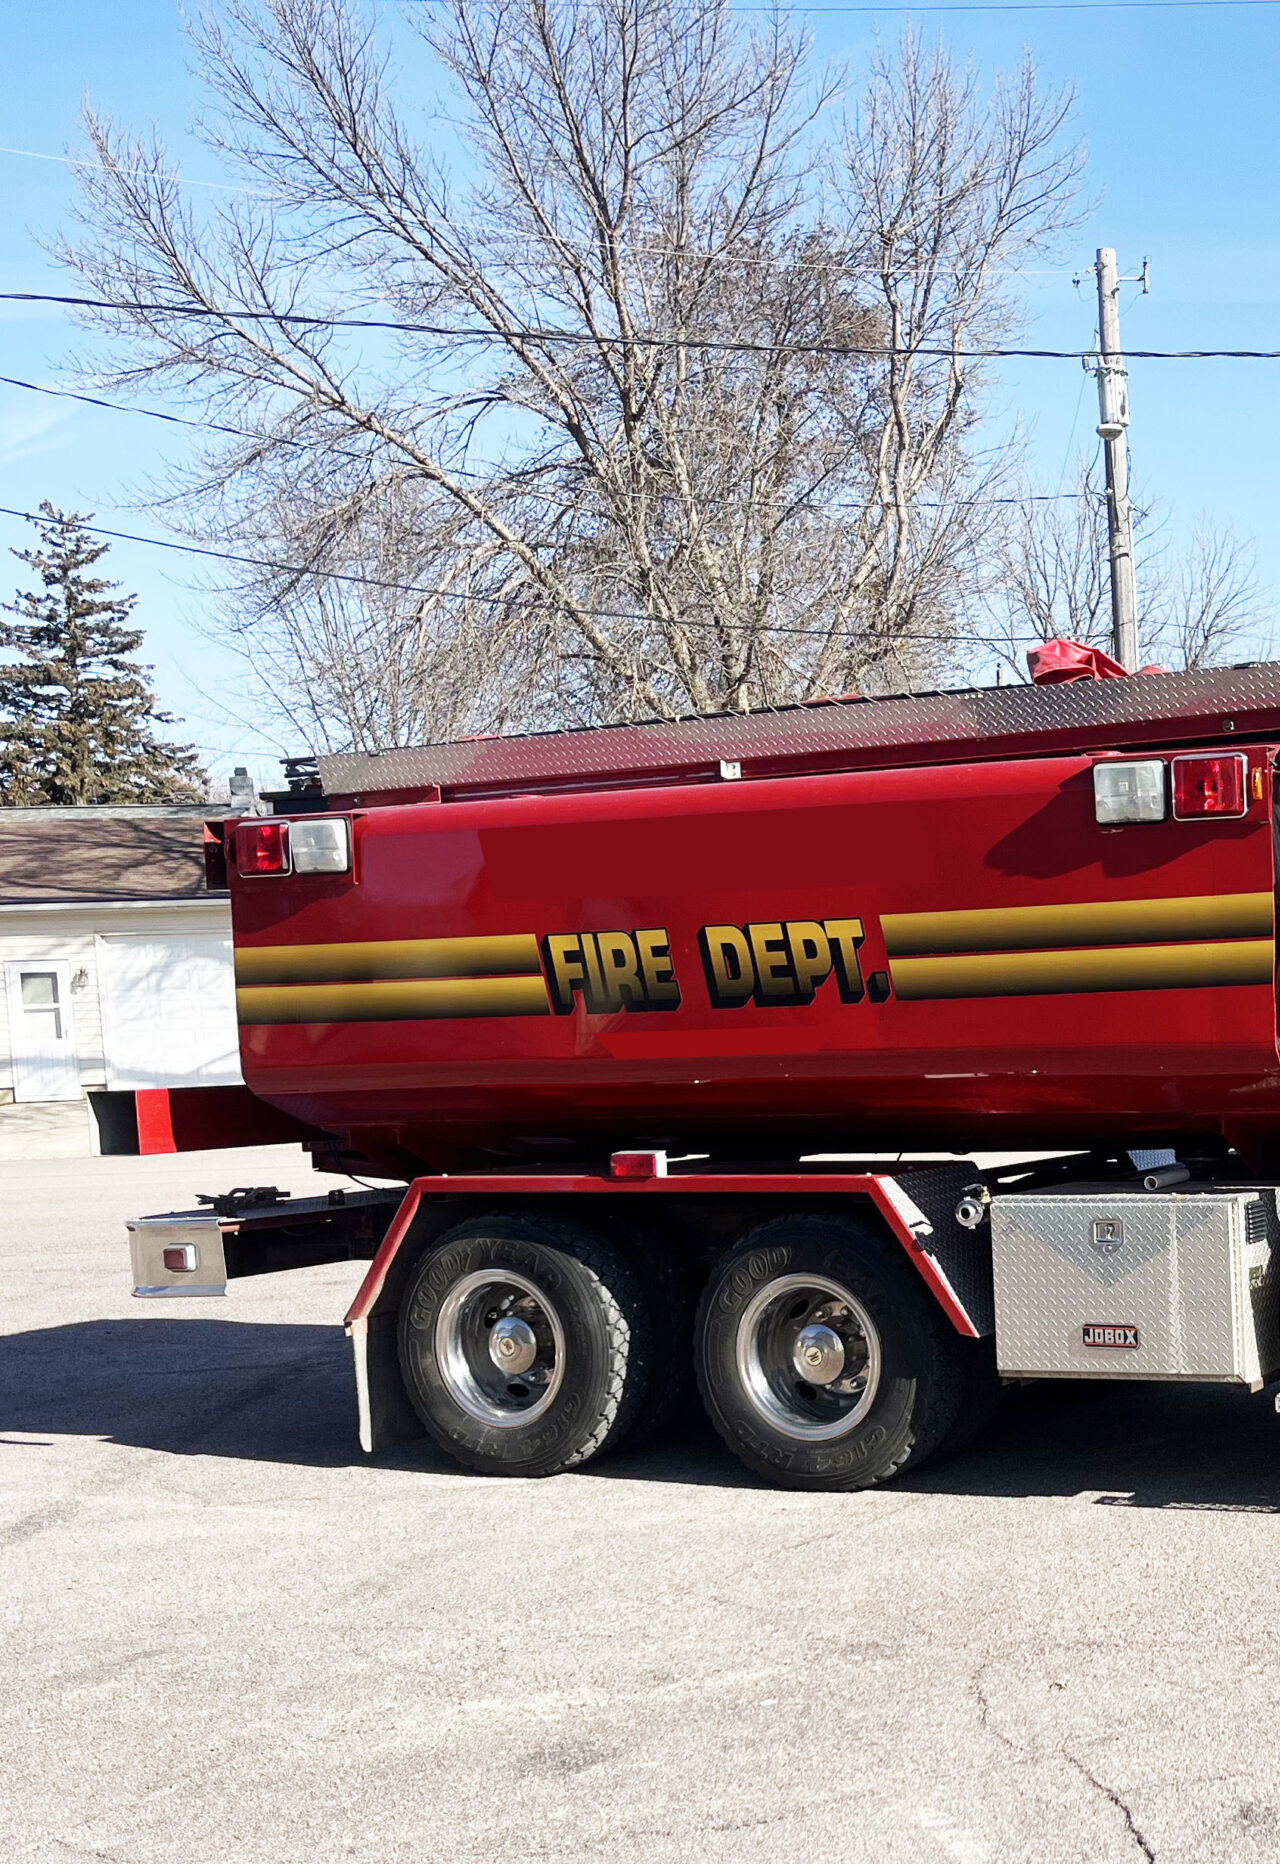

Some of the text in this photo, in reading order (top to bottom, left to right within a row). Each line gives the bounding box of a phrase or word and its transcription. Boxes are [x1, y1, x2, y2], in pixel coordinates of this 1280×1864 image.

[541, 916, 892, 1016] FIRE DEPT.
[1083, 1328, 1138, 1345] JOBOX
